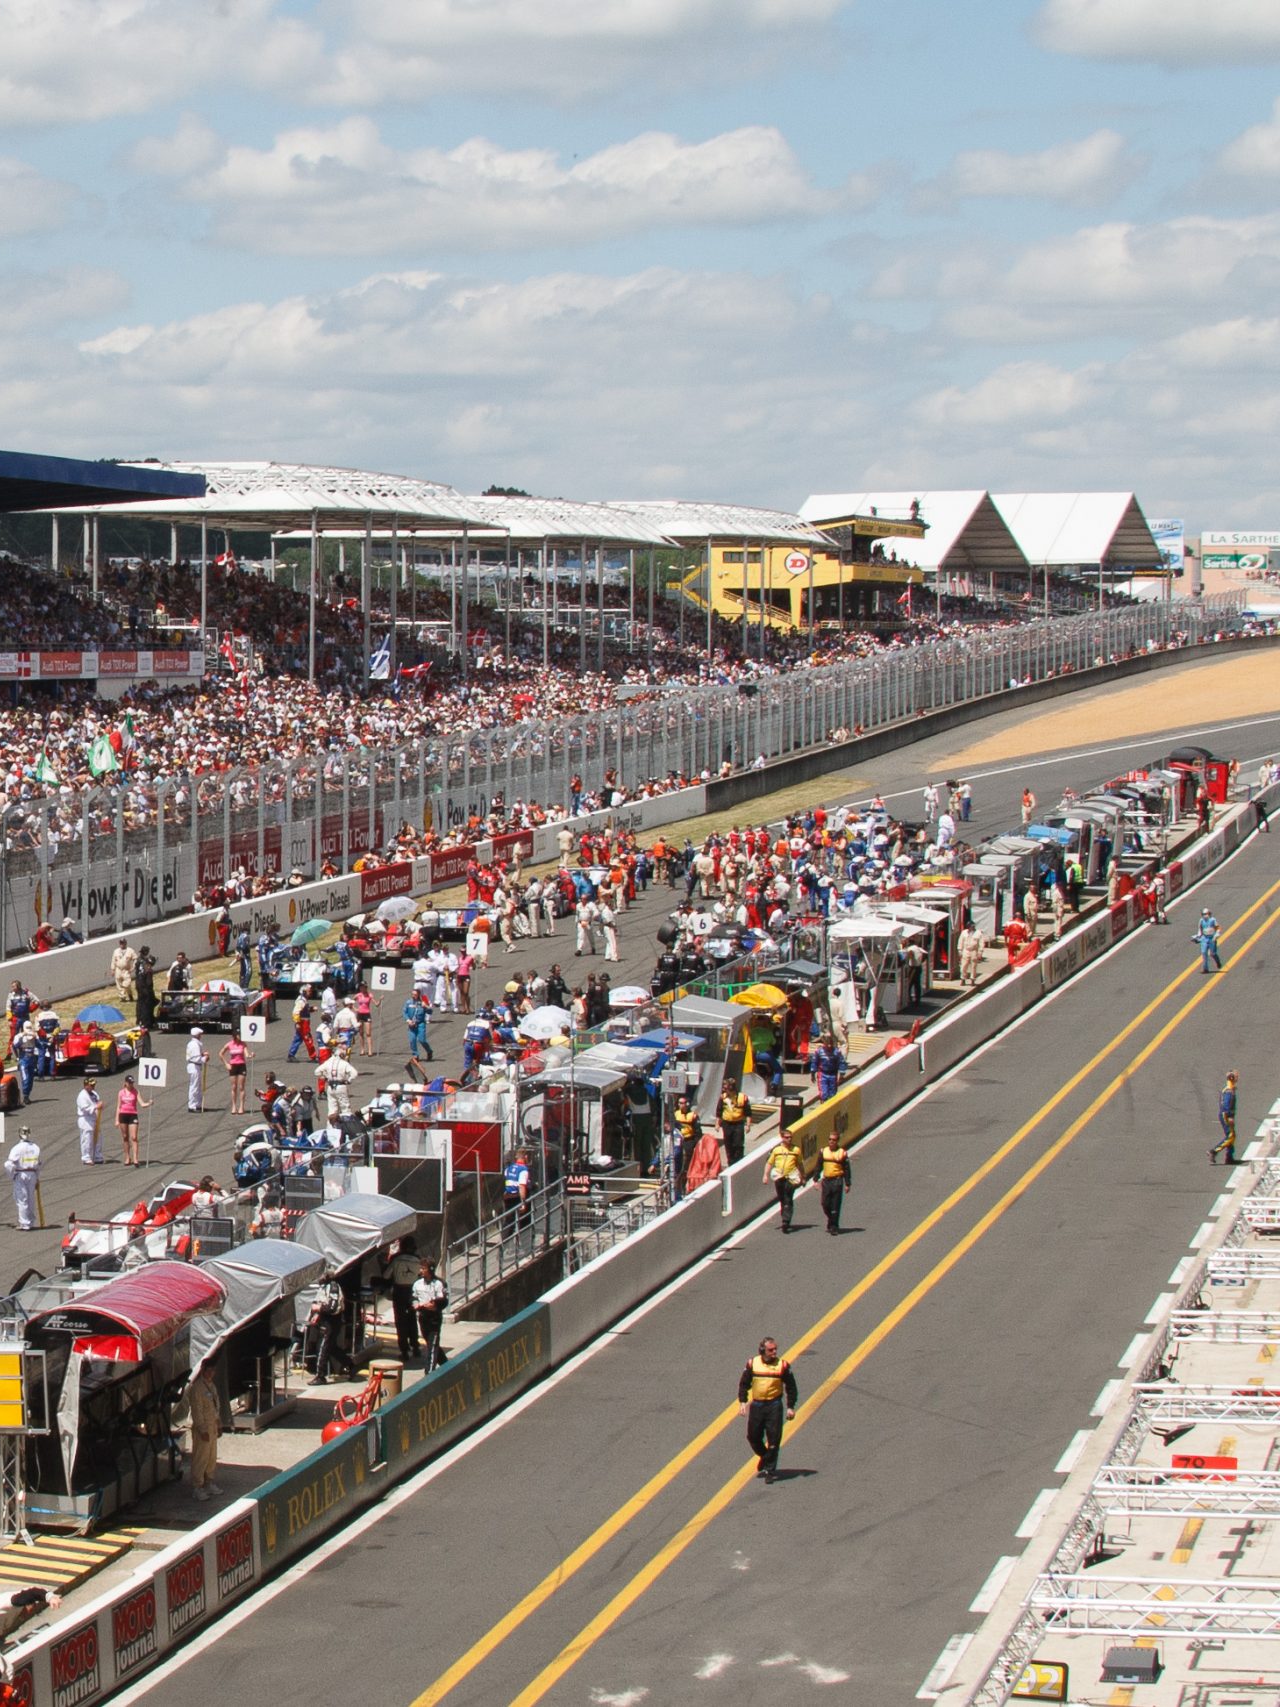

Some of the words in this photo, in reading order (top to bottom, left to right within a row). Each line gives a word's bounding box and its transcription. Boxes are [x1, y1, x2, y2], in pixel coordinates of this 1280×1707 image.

[1210, 534, 1227, 543] LA
[1231, 533, 1280, 544] SARTHE
[789, 558, 807, 568] D
[1203, 559, 1237, 568] Sarthe
[42, 660, 54, 671] Audi
[65, 660, 81, 671] Power
[100, 659, 112, 670] Audi
[122, 660, 137, 671] Power
[433, 862, 449, 879] Audi
[364, 879, 380, 898] Audi
[380, 877, 392, 895] TDI
[392, 873, 410, 893] Power
[299, 896, 329, 920] V-Power
[330, 886, 351, 912] Diesel
[699, 918, 706, 930] 6
[472, 938, 480, 951] 7
[378, 972, 388, 985] 8
[248, 1022, 258, 1037] 9
[144, 1064, 161, 1080] 10
[567, 1175, 590, 1185] AMR
[487, 1334, 531, 1392] ROLEX
[419, 1378, 468, 1442] ROLEX
[287, 1462, 347, 1537] ROLEX
[216, 1518, 252, 1575] MOTO
[167, 1552, 205, 1610] MOTO
[112, 1587, 157, 1651] MOTO
[51, 1625, 98, 1691] MOTO
[1018, 1665, 1059, 1696] 92
